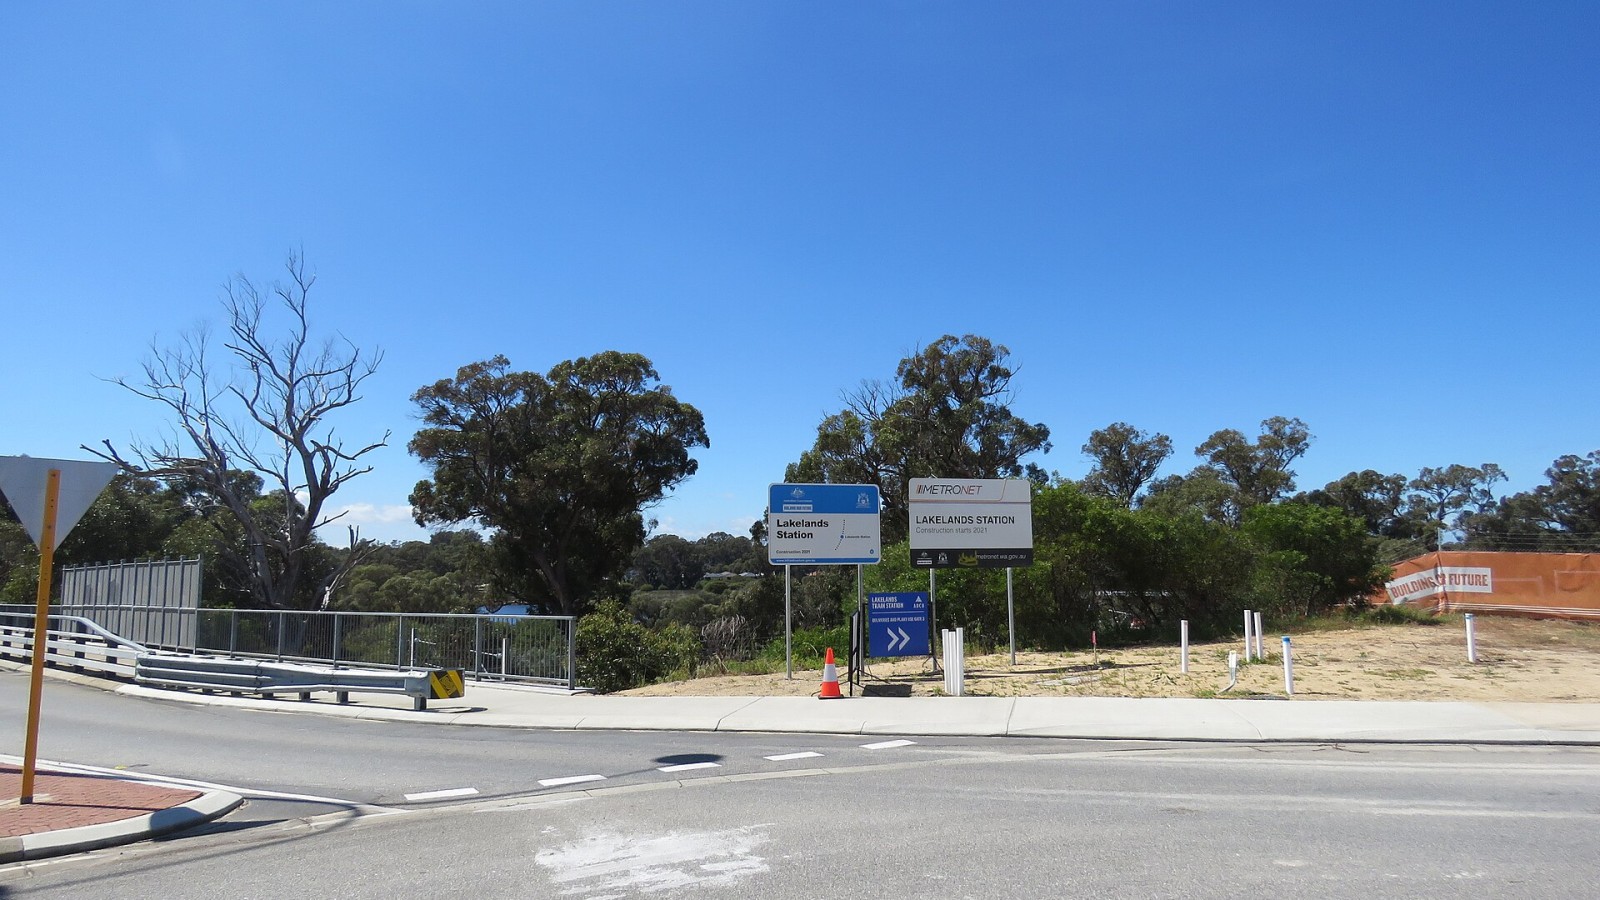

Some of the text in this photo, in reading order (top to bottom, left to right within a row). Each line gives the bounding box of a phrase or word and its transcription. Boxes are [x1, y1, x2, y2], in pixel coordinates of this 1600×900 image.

[923, 484, 982, 495] METRONET
[776, 520, 828, 528] Lakelands
[916, 516, 1014, 524] LAKELANDS STATION
[776, 530, 813, 538] Station
[1391, 576, 1437, 598] BUILDING
[1448, 574, 1488, 586] FUTURE
